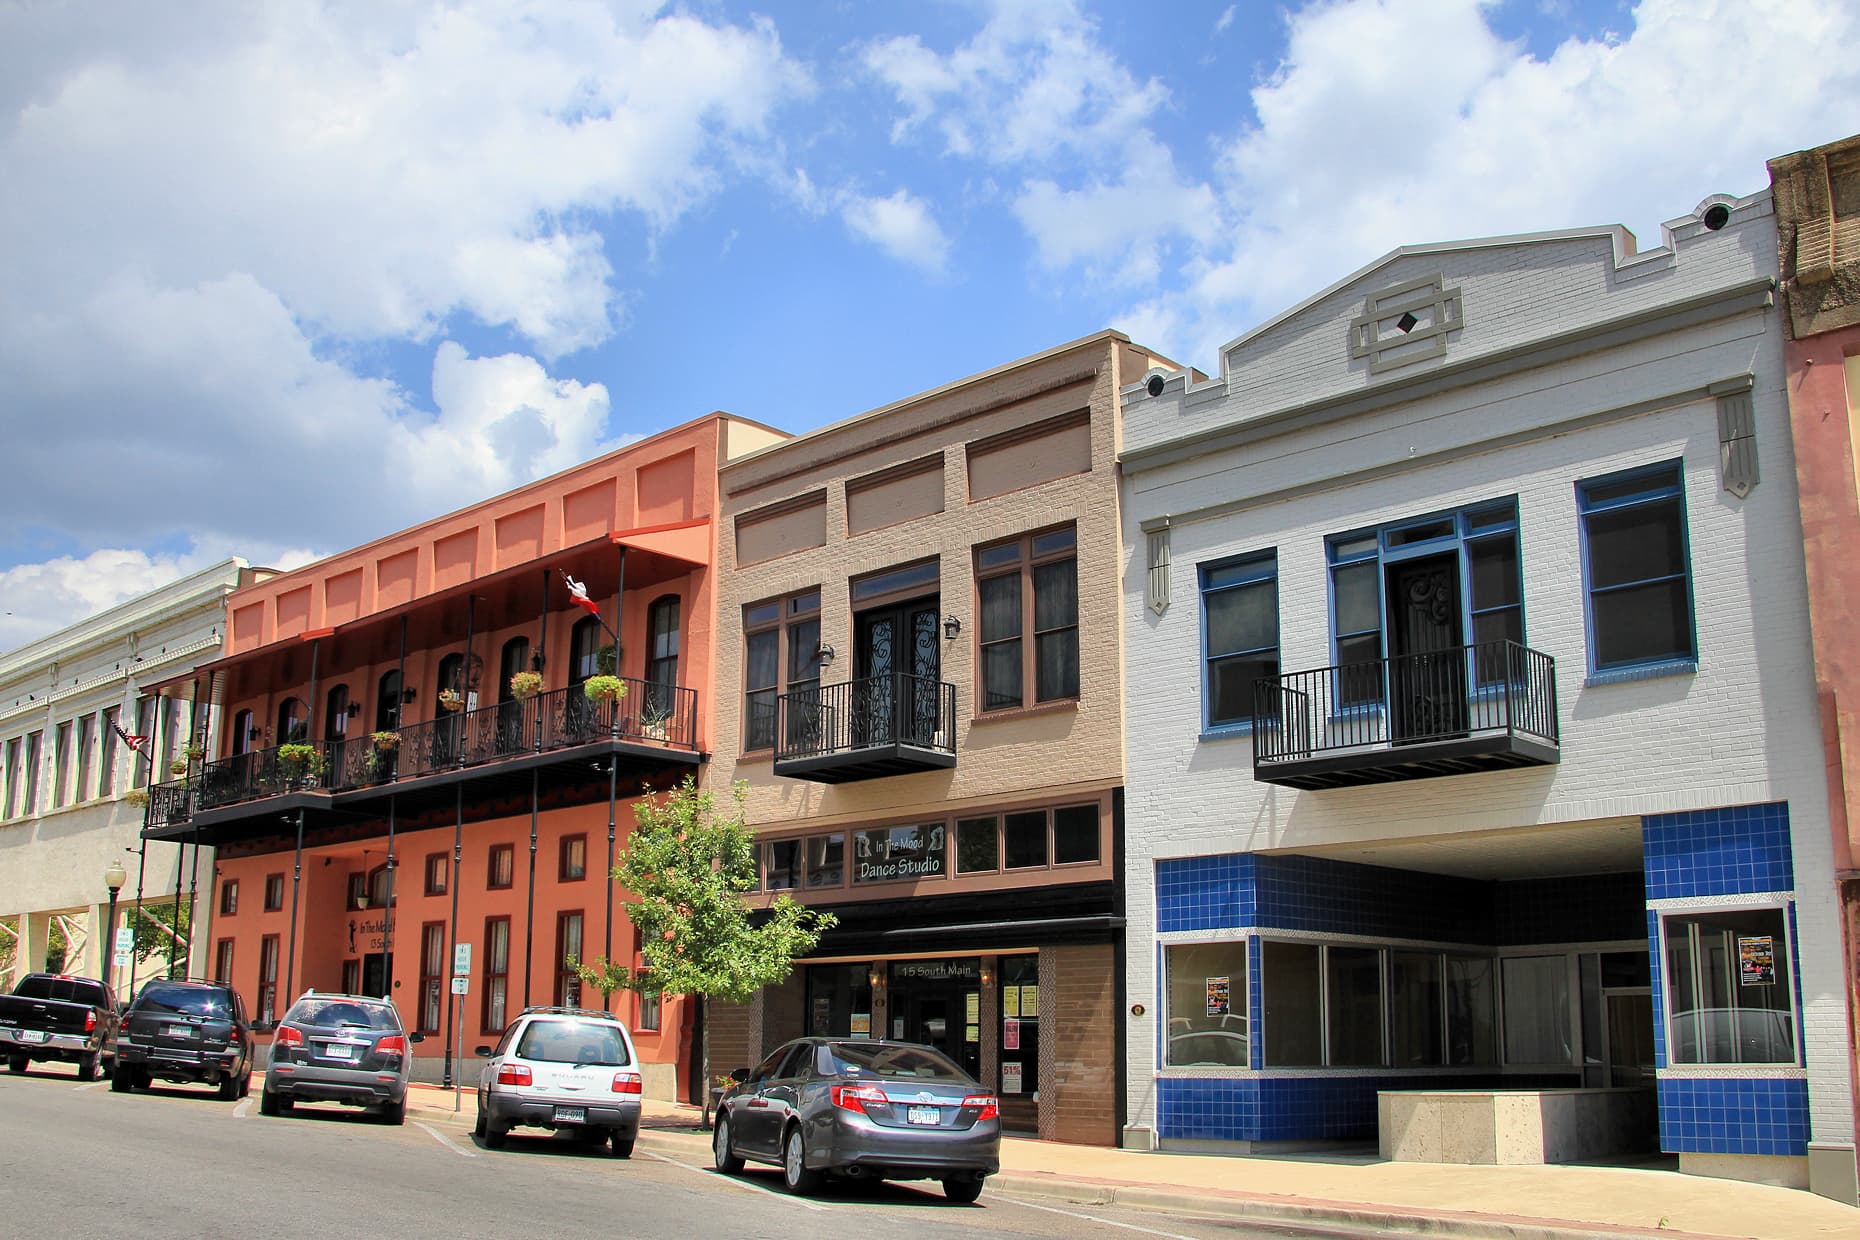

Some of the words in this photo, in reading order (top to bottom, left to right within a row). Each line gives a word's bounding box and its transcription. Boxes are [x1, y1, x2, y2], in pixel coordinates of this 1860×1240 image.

[876, 840, 883, 853] In
[885, 838, 899, 852] The
[900, 835, 924, 849] Mood
[861, 862, 896, 878] Dance
[898, 856, 940, 874] Studio
[903, 966, 916, 977] 15
[917, 965, 946, 977] South
[948, 963, 971, 976] Main
[1004, 1066, 1020, 1076] 51%
